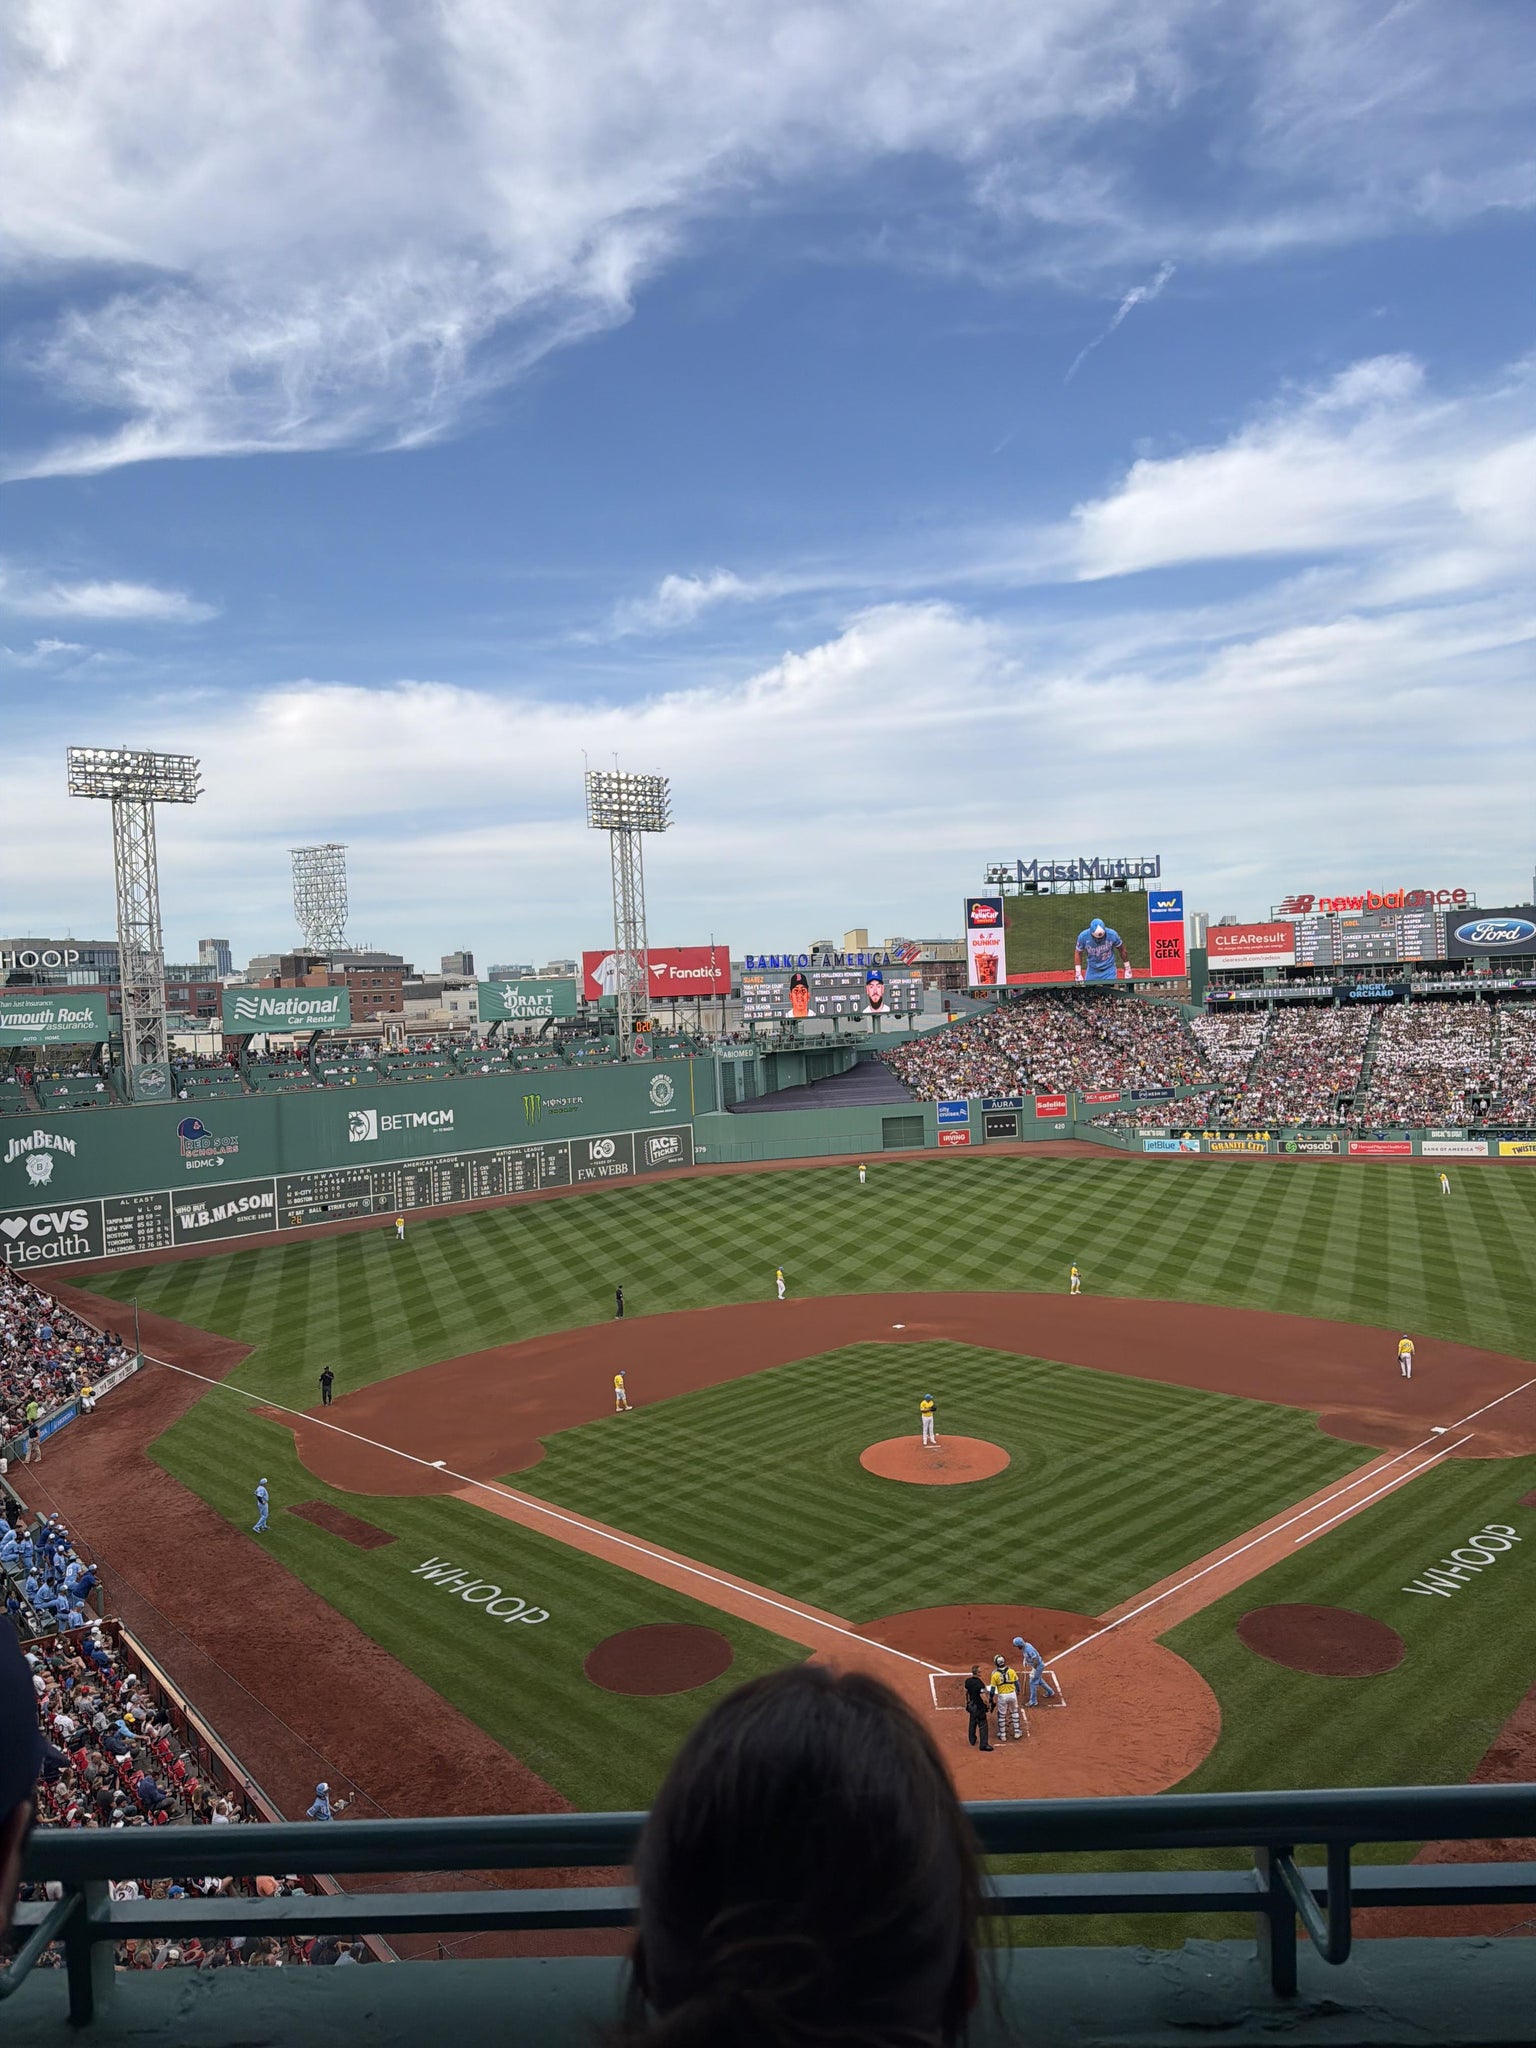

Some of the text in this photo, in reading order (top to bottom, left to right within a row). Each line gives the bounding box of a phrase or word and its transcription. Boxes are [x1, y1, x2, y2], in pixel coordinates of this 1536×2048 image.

[1017, 855, 1160, 881] MassMutual
[1319, 895, 1363, 911] new
[1367, 888, 1467, 910] balance
[1471, 922, 1521, 942] Ford
[1156, 939, 1179, 949] SEAT
[1215, 932, 1285, 945] CLEAResult
[1087, 941, 1113, 957] Royals
[1155, 949, 1180, 959] GEEK
[746, 952, 890, 969] BANK OF AMERICA
[669, 965, 722, 980] Fanatics
[1356, 983, 1387, 991] ANGRY
[1349, 989, 1395, 998] ORCHARD
[504, 995, 554, 1009] DRAFT
[820, 1002, 858, 1013] 0 0 0
[58, 1008, 94, 1022] Rock
[511, 1005, 552, 1017] KINGS
[288, 1014, 335, 1025] Car Rental
[46, 1022, 94, 1031] assurance
[723, 1050, 754, 1059] ABIOMED
[542, 1096, 584, 1107] MONSTER
[1037, 1101, 1066, 1109] Safelite
[381, 1109, 454, 1131] BETMGM
[185, 1136, 239, 1150] RED SOX
[589, 1138, 615, 1160] 160
[653, 1137, 678, 1151] ACE
[1147, 1141, 1176, 1150] jetBlue
[1211, 1141, 1265, 1151] GRANITE CITY
[1298, 1141, 1333, 1150] wasabi
[186, 1145, 239, 1157] SCHOLARS
[653, 1146, 678, 1159] TICKET
[186, 1159, 214, 1169] BIDMC
[403, 1160, 433, 1168] AMERICAN
[301, 1168, 371, 1182] FENWAY PARK
[577, 1163, 628, 1180] F.W. WEBB
[133, 1196, 155, 1204] EAST
[175, 1206, 191, 1214] WHO
[30, 1209, 89, 1236] CVS
[291, 1216, 302, 1225] 28
[107, 1238, 133, 1246] TORONTO
[4, 1234, 90, 1264] Health
[107, 1245, 135, 1254] BALTIMORE
[1401, 1524, 1522, 1597] WHOOP
[410, 1557, 550, 1624] WHOOP
